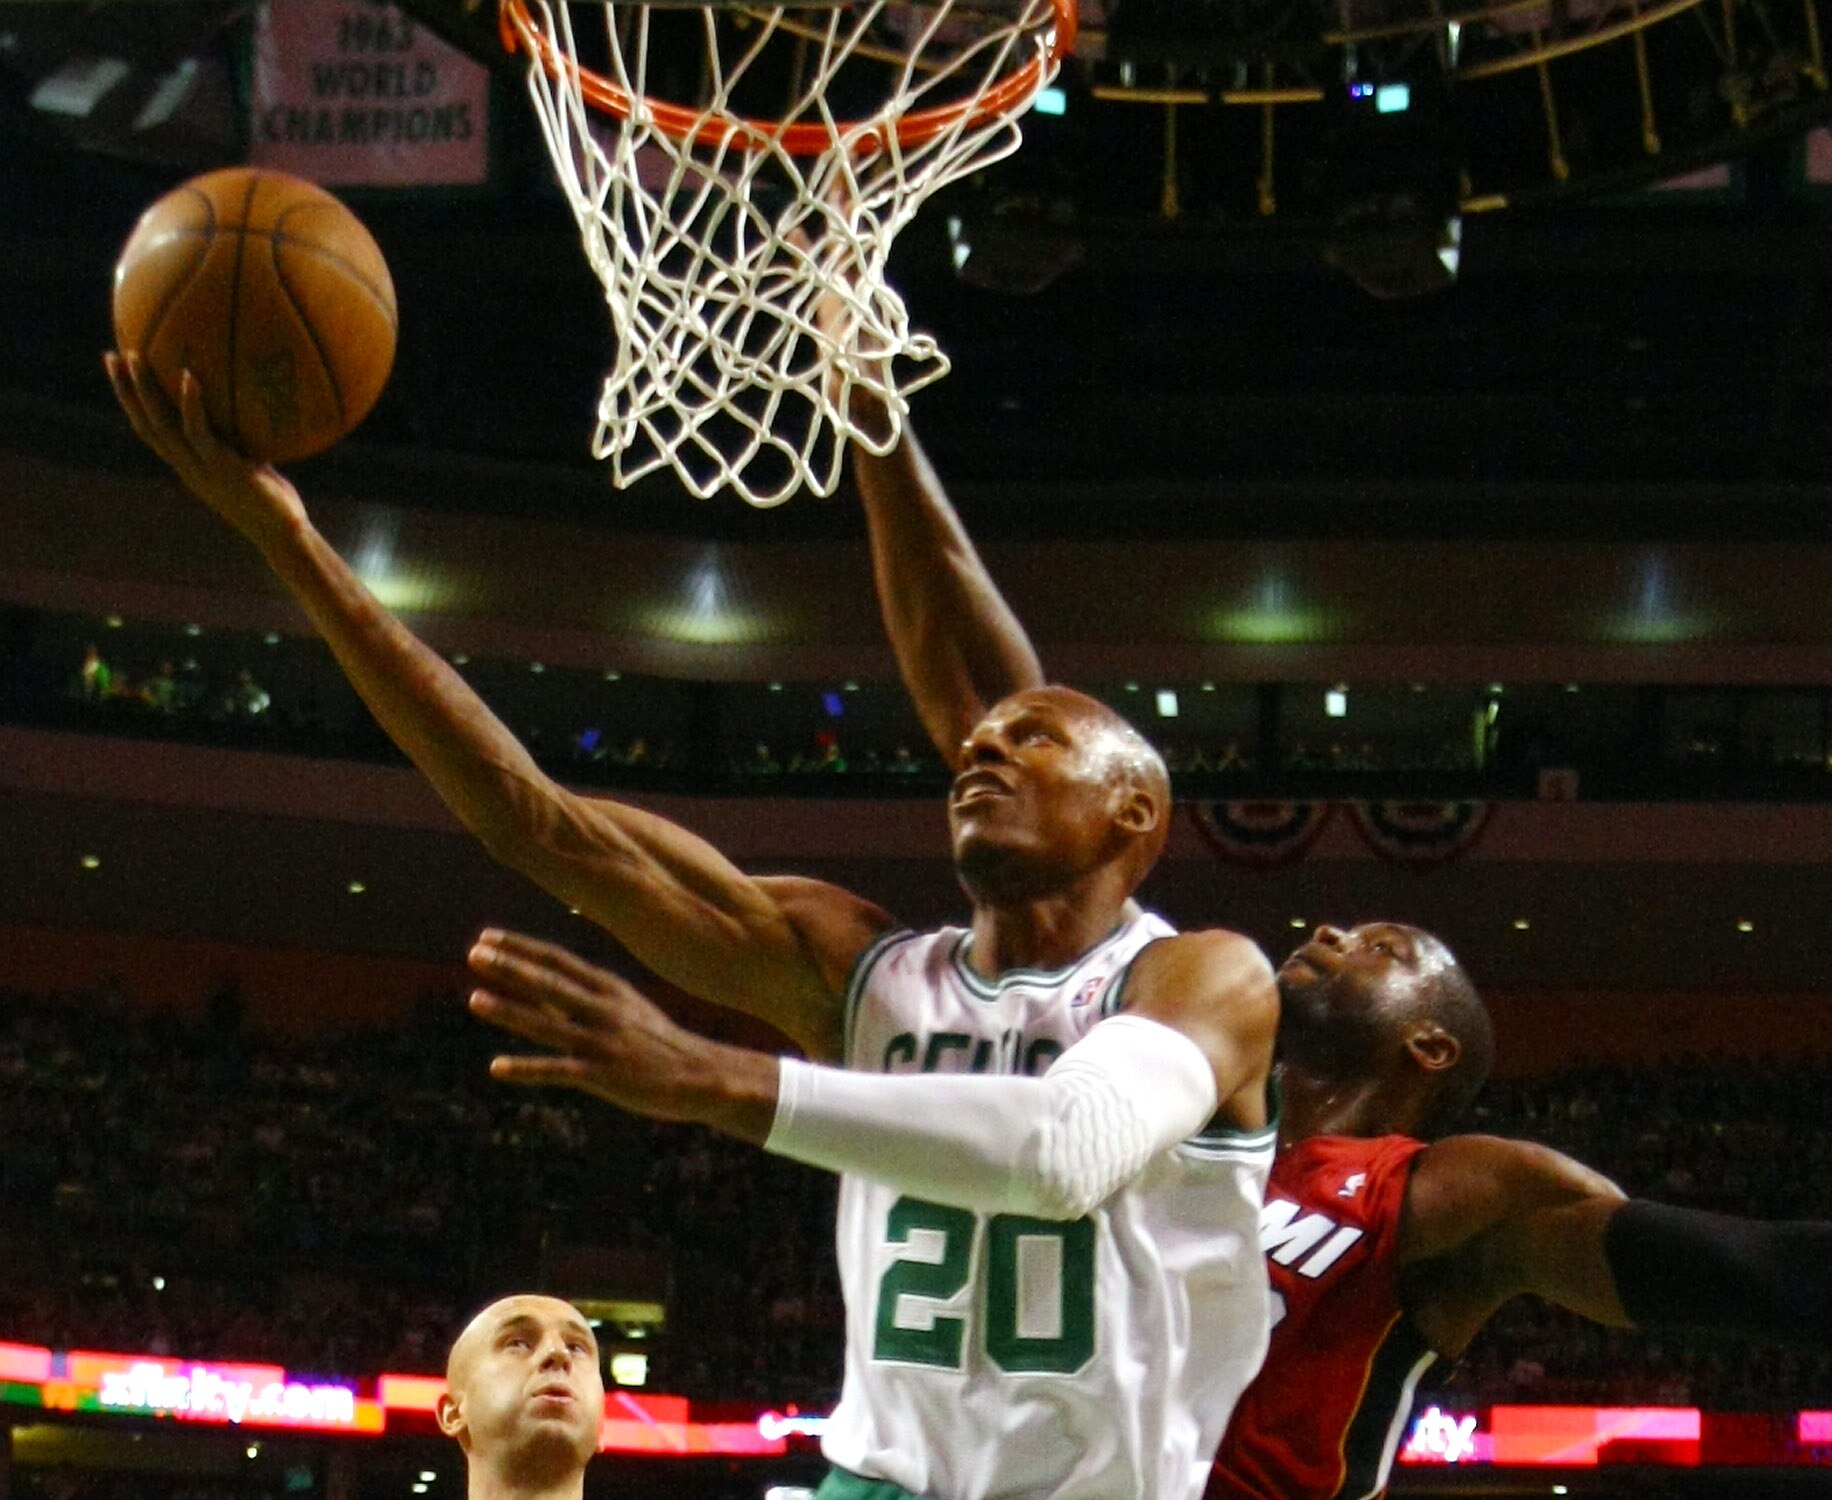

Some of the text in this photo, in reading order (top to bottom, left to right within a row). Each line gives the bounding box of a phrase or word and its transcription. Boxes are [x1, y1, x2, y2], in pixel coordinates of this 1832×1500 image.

[313, 60, 436, 98] WORLD
[260, 104, 471, 142] CHAMPIONS
[872, 1194, 1096, 1374] 20
